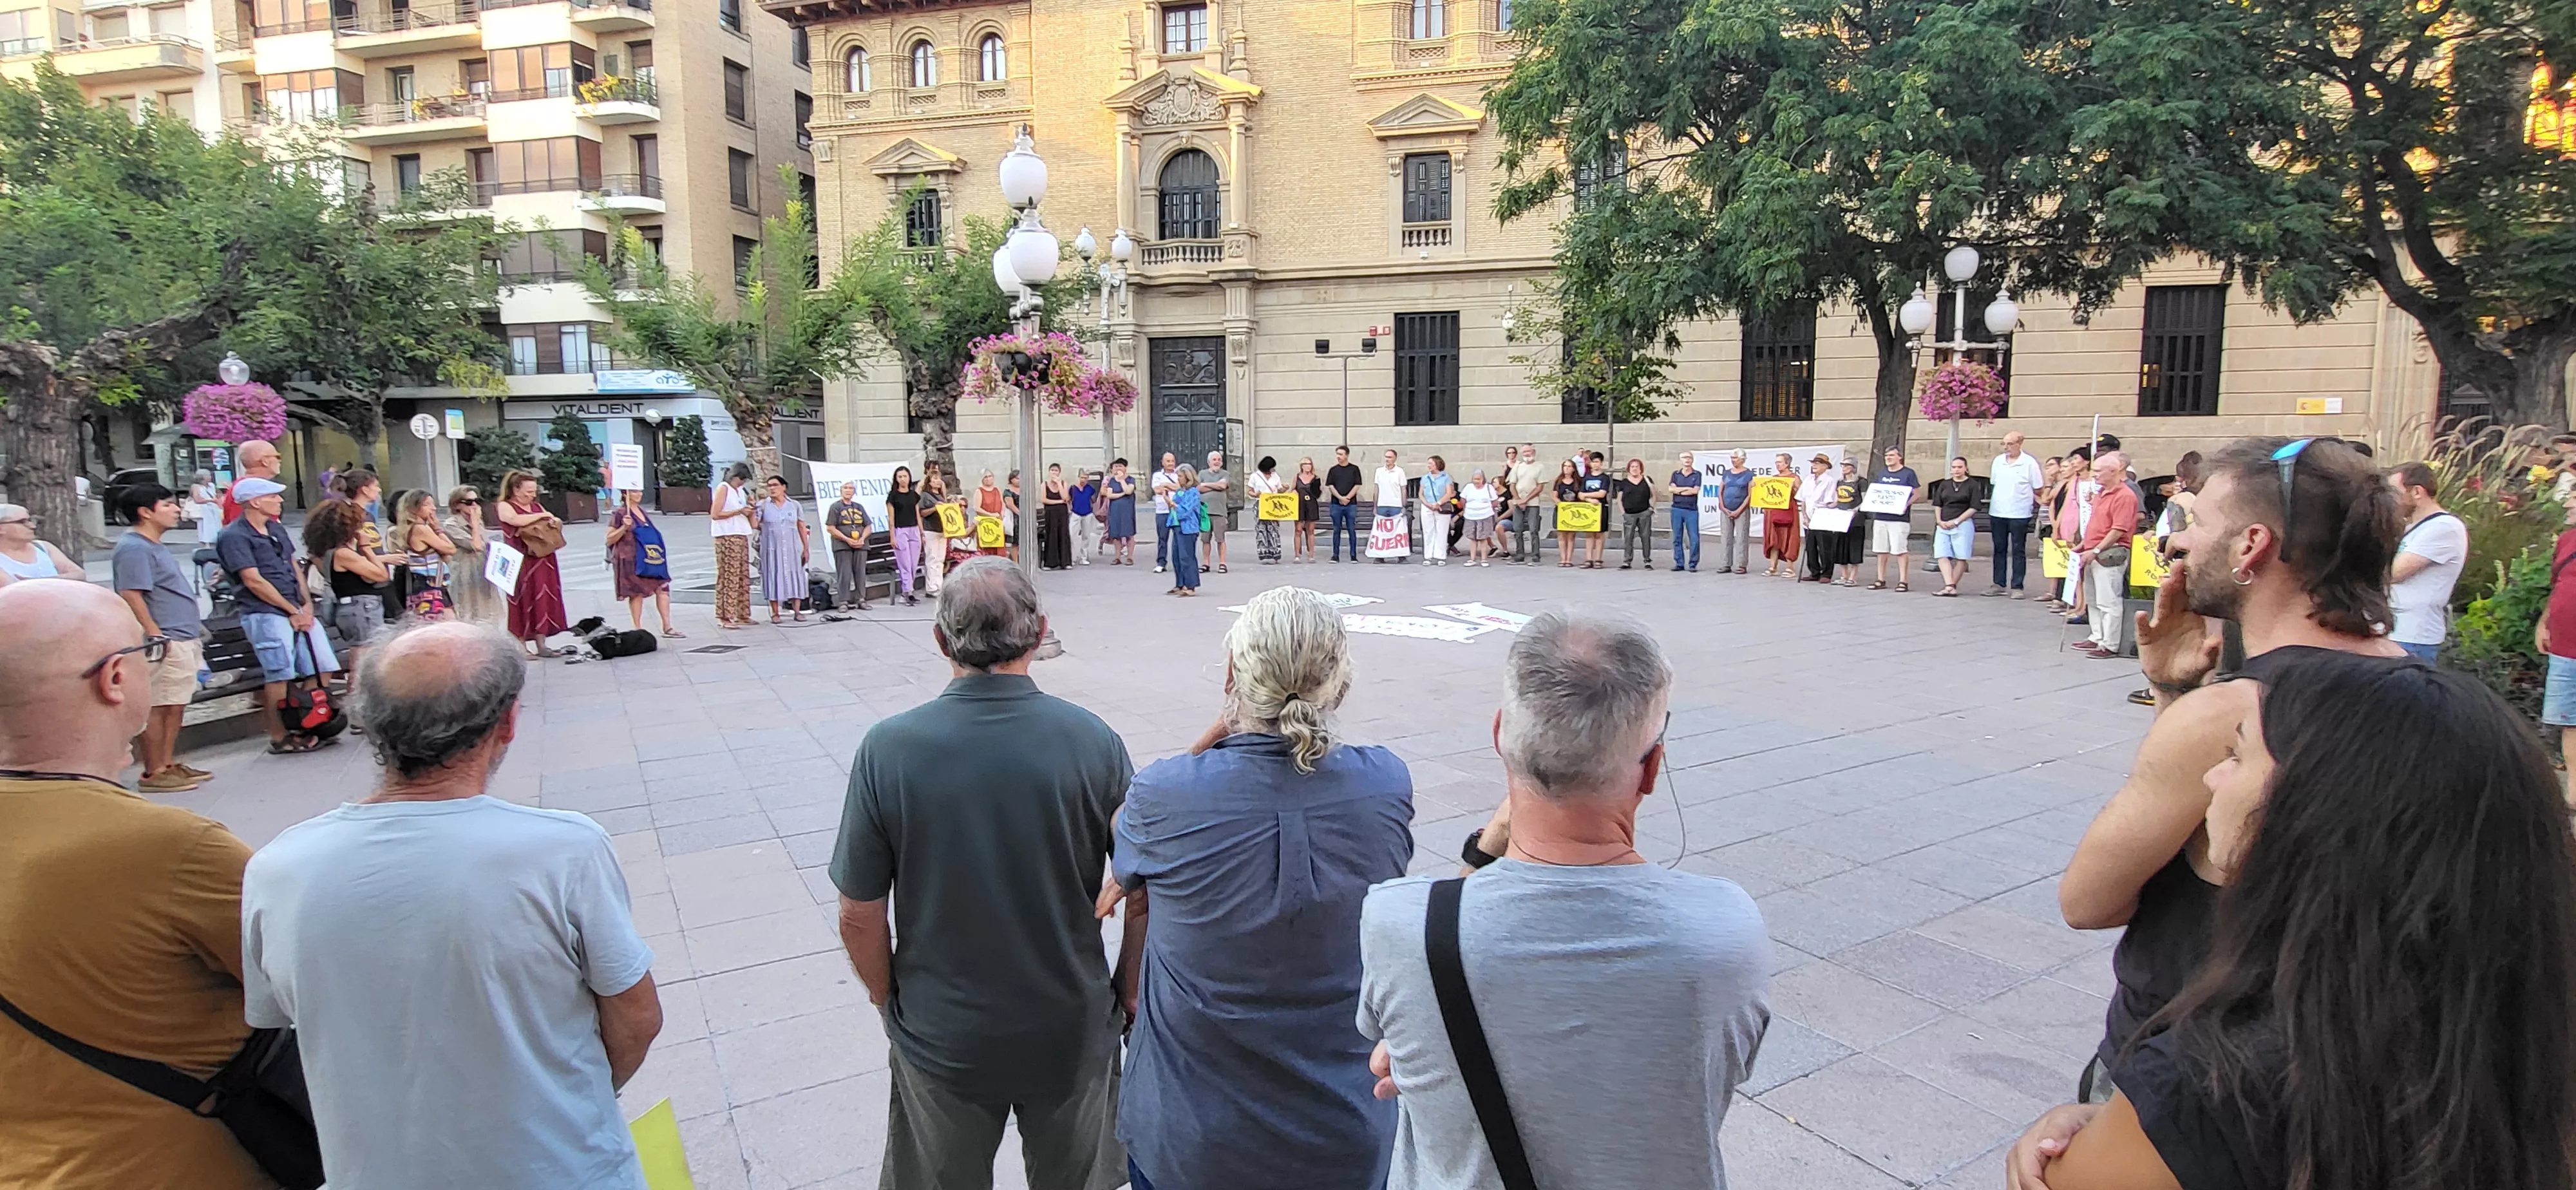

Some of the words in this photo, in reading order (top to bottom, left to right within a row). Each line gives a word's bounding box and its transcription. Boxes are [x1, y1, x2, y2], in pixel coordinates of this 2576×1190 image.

[552, 403, 644, 415] VITALDENT
[773, 406, 819, 419] ALDENT
[1706, 464, 1726, 477] NO
[1752, 468, 1772, 477] EDE
[817, 478, 892, 499] BIEVENID
[1704, 505, 1717, 513] UN
